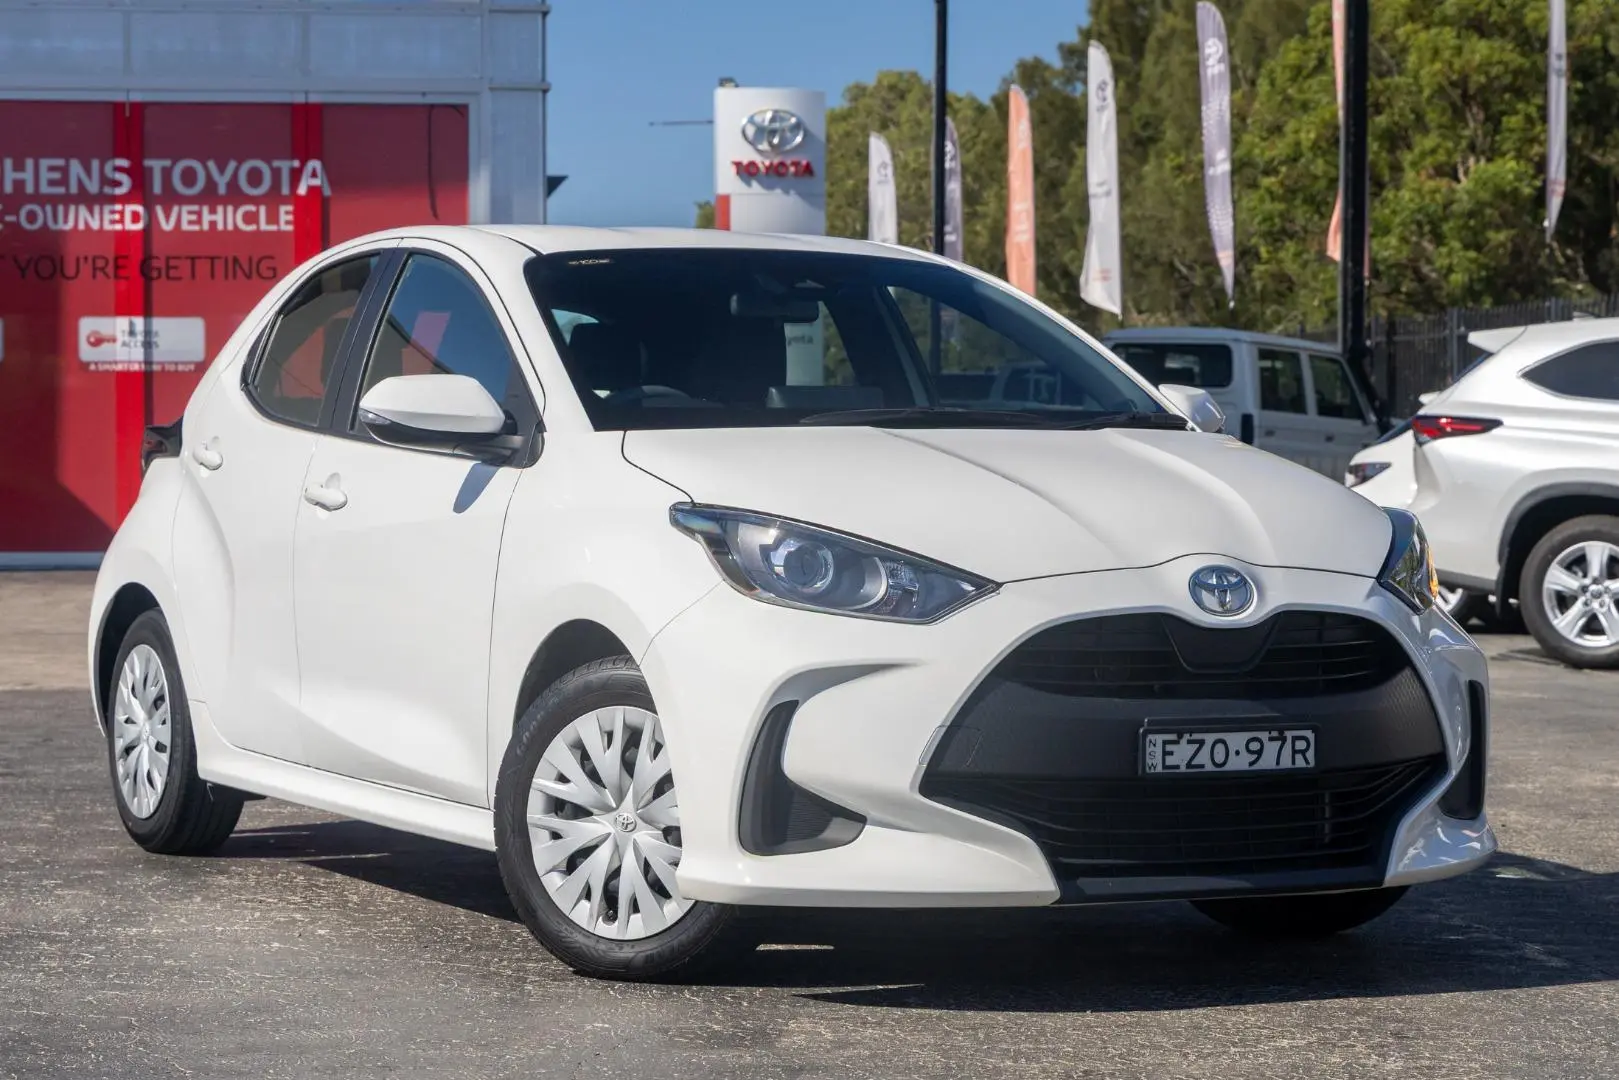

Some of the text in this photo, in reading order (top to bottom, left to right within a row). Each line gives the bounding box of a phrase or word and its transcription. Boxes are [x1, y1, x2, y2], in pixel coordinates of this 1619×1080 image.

[142, 158, 332, 197] TOYOTA
[732, 160, 815, 178] TOYOTA
[0, 203, 295, 232] -OWNED VEHICLE
[13, 254, 131, 282] YOU'RE
[140, 254, 278, 282] GETTING
